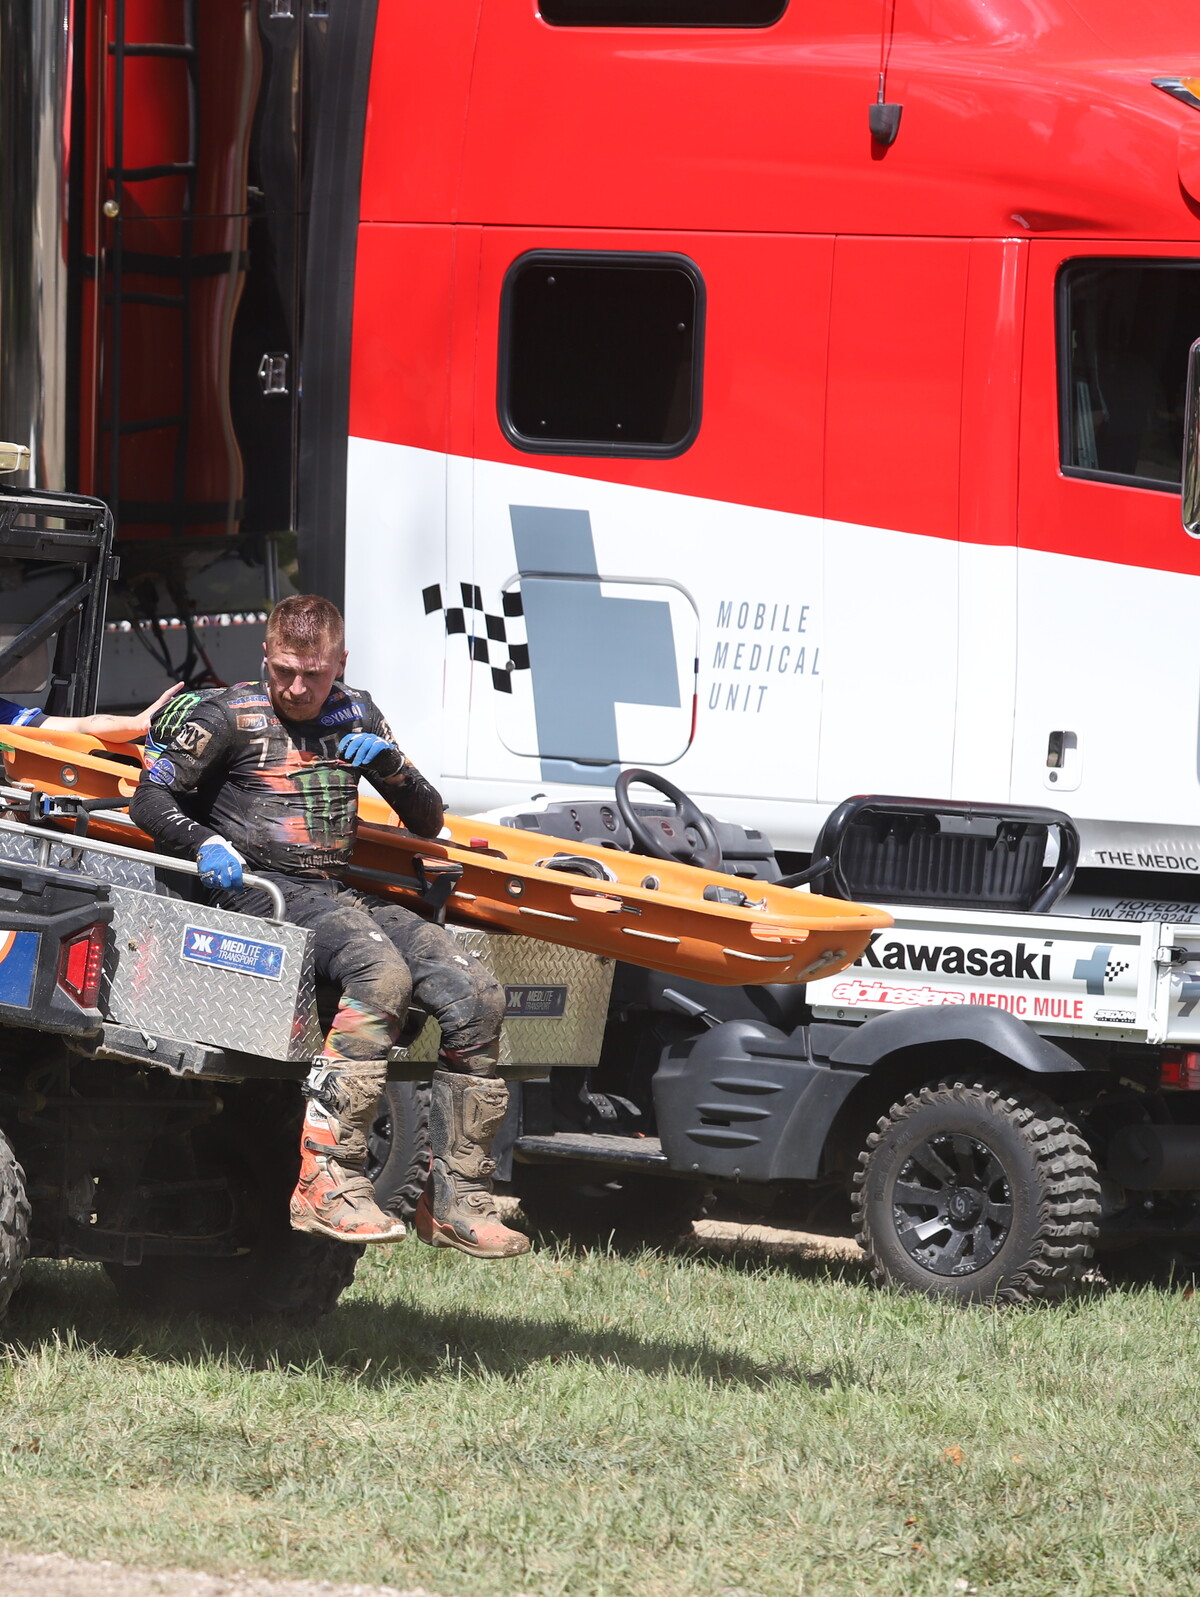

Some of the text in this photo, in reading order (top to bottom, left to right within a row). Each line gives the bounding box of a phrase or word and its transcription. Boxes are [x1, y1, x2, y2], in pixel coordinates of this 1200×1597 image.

[716, 600, 810, 633] MOBILE
[712, 642, 821, 676] MEDICAL
[708, 682, 769, 713] UNIT
[1094, 851, 1199, 871] THE MEDIC
[1090, 907, 1115, 918] VIN
[218, 949, 258, 966] TRANSPORT
[220, 938, 262, 958] MEDLITE
[853, 932, 1054, 981] Kawasaki
[970, 992, 1027, 1015] MEDIC
[1033, 997, 1084, 1019] MULE
